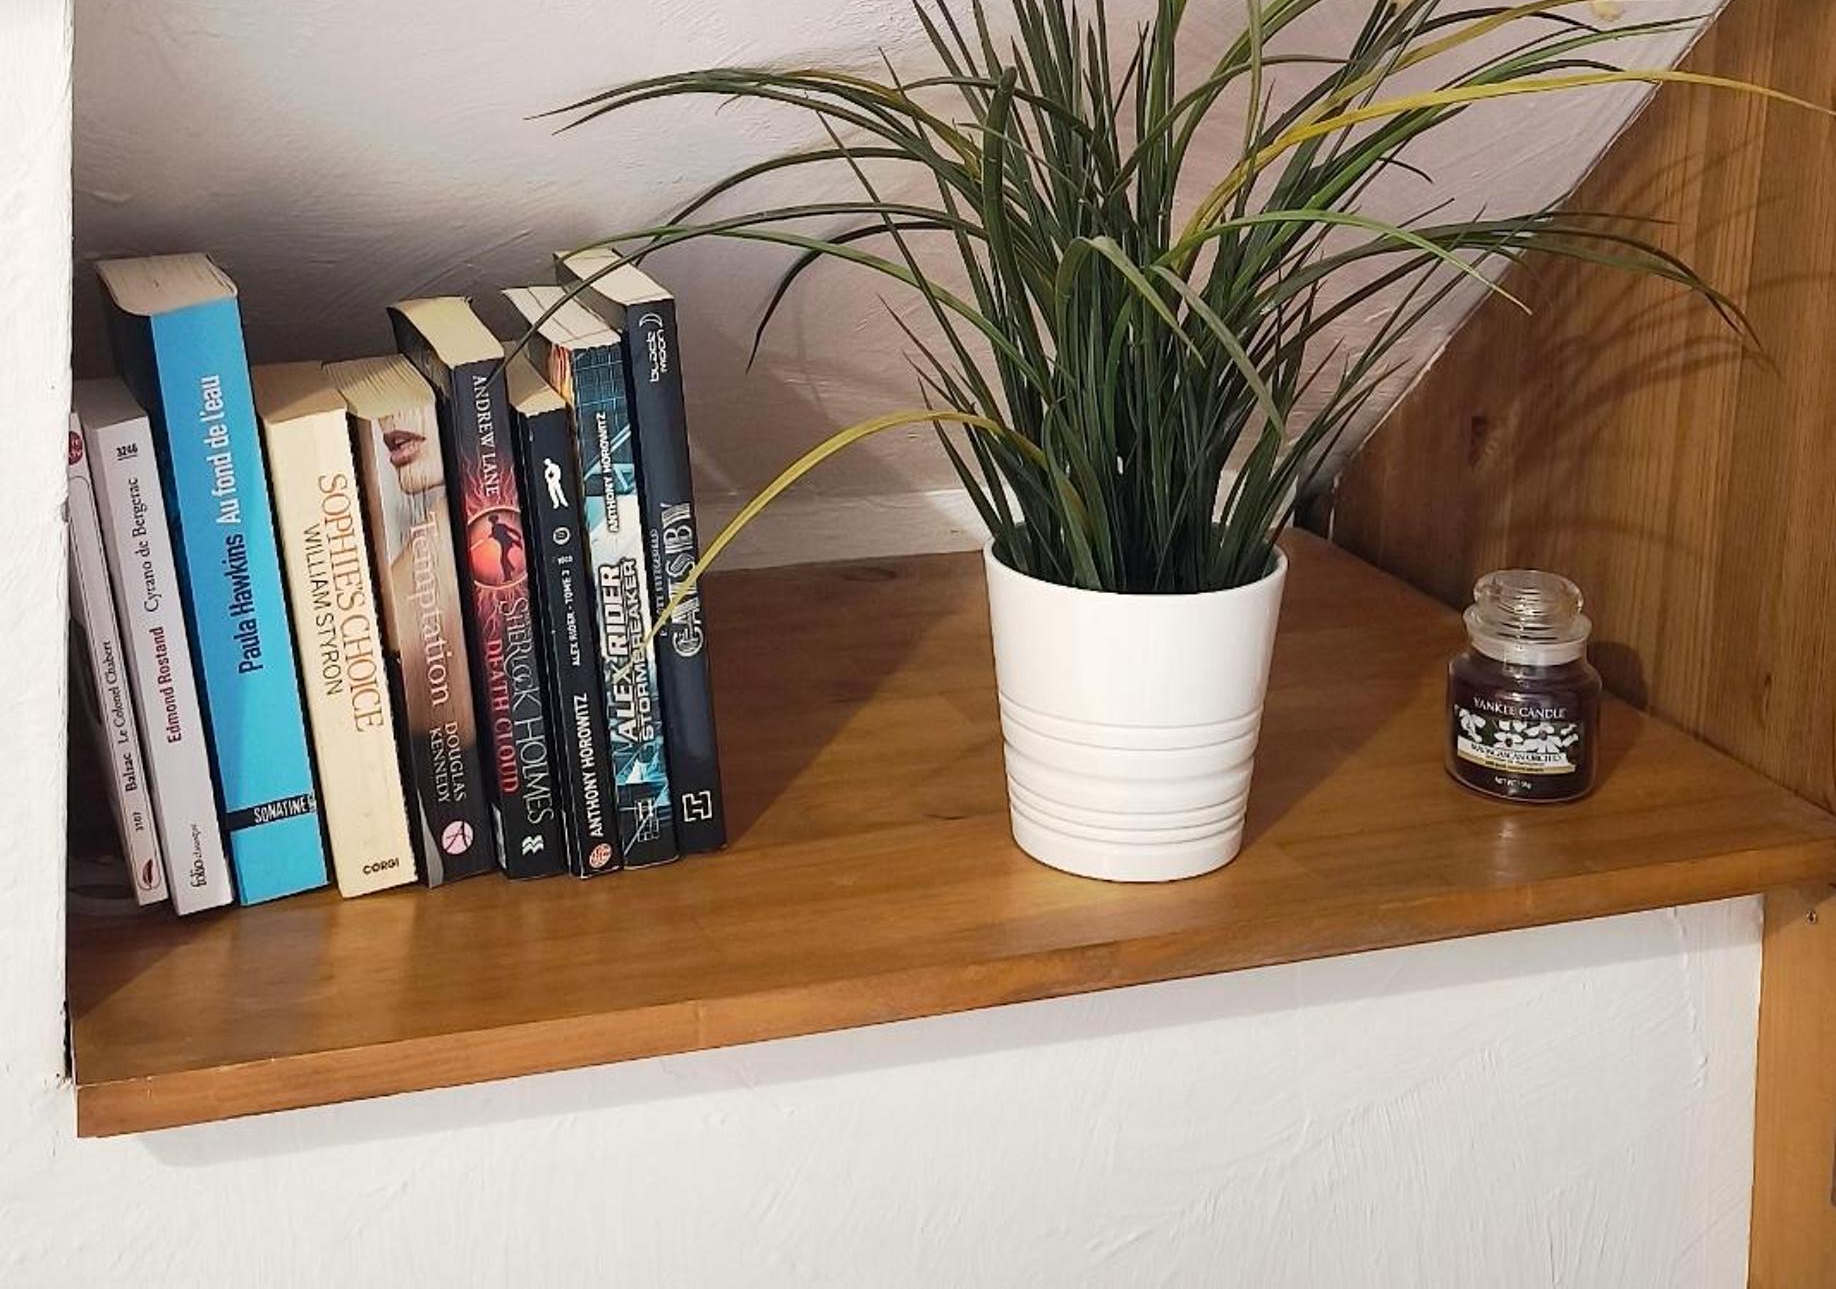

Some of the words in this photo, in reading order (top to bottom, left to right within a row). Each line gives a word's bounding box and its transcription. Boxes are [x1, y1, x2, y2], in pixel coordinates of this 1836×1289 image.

[199, 373, 224, 423] l'eau
[471, 375, 496, 450] ANDREW
[203, 423, 230, 451] de
[596, 412, 611, 474] HOROWITZ
[206, 452, 237, 498] fond
[480, 451, 500, 497] LANE
[603, 475, 618, 532] ANTHONY
[128, 477, 148, 538] Bergerac
[215, 500, 241, 526] Au
[134, 540, 150, 558] de
[224, 534, 257, 617] Hawkins
[303, 523, 331, 611] WILLIAM
[318, 473, 366, 612] SOPHIE'S
[142, 560, 163, 613] Cyrano
[408, 510, 452, 706] Temptation
[562, 577, 574, 605] TOME
[600, 565, 630, 655] RIDER
[150, 626, 174, 686] Rostand
[233, 619, 263, 674] Paula
[315, 613, 344, 696] STYRON
[340, 614, 384, 732] CHOICE
[486, 640, 510, 711] DEATH
[498, 597, 542, 712] SHERLOCK
[624, 559, 655, 741] STORMBREAKER
[163, 687, 182, 745] Edmond
[573, 693, 595, 767] HOROWITZ
[612, 660, 639, 742] ALEX
[1519, 706, 1568, 719] CANDLE
[125, 751, 138, 793] Balzac
[428, 727, 452, 804] KENNEDY
[444, 720, 467, 803] DOUGLAS
[493, 717, 519, 794] CLOUD
[513, 715, 555, 825] HOLMES
[253, 795, 309, 824] SONATINE
[582, 768, 604, 838] ANTHONY
[361, 858, 400, 876] CORGI
